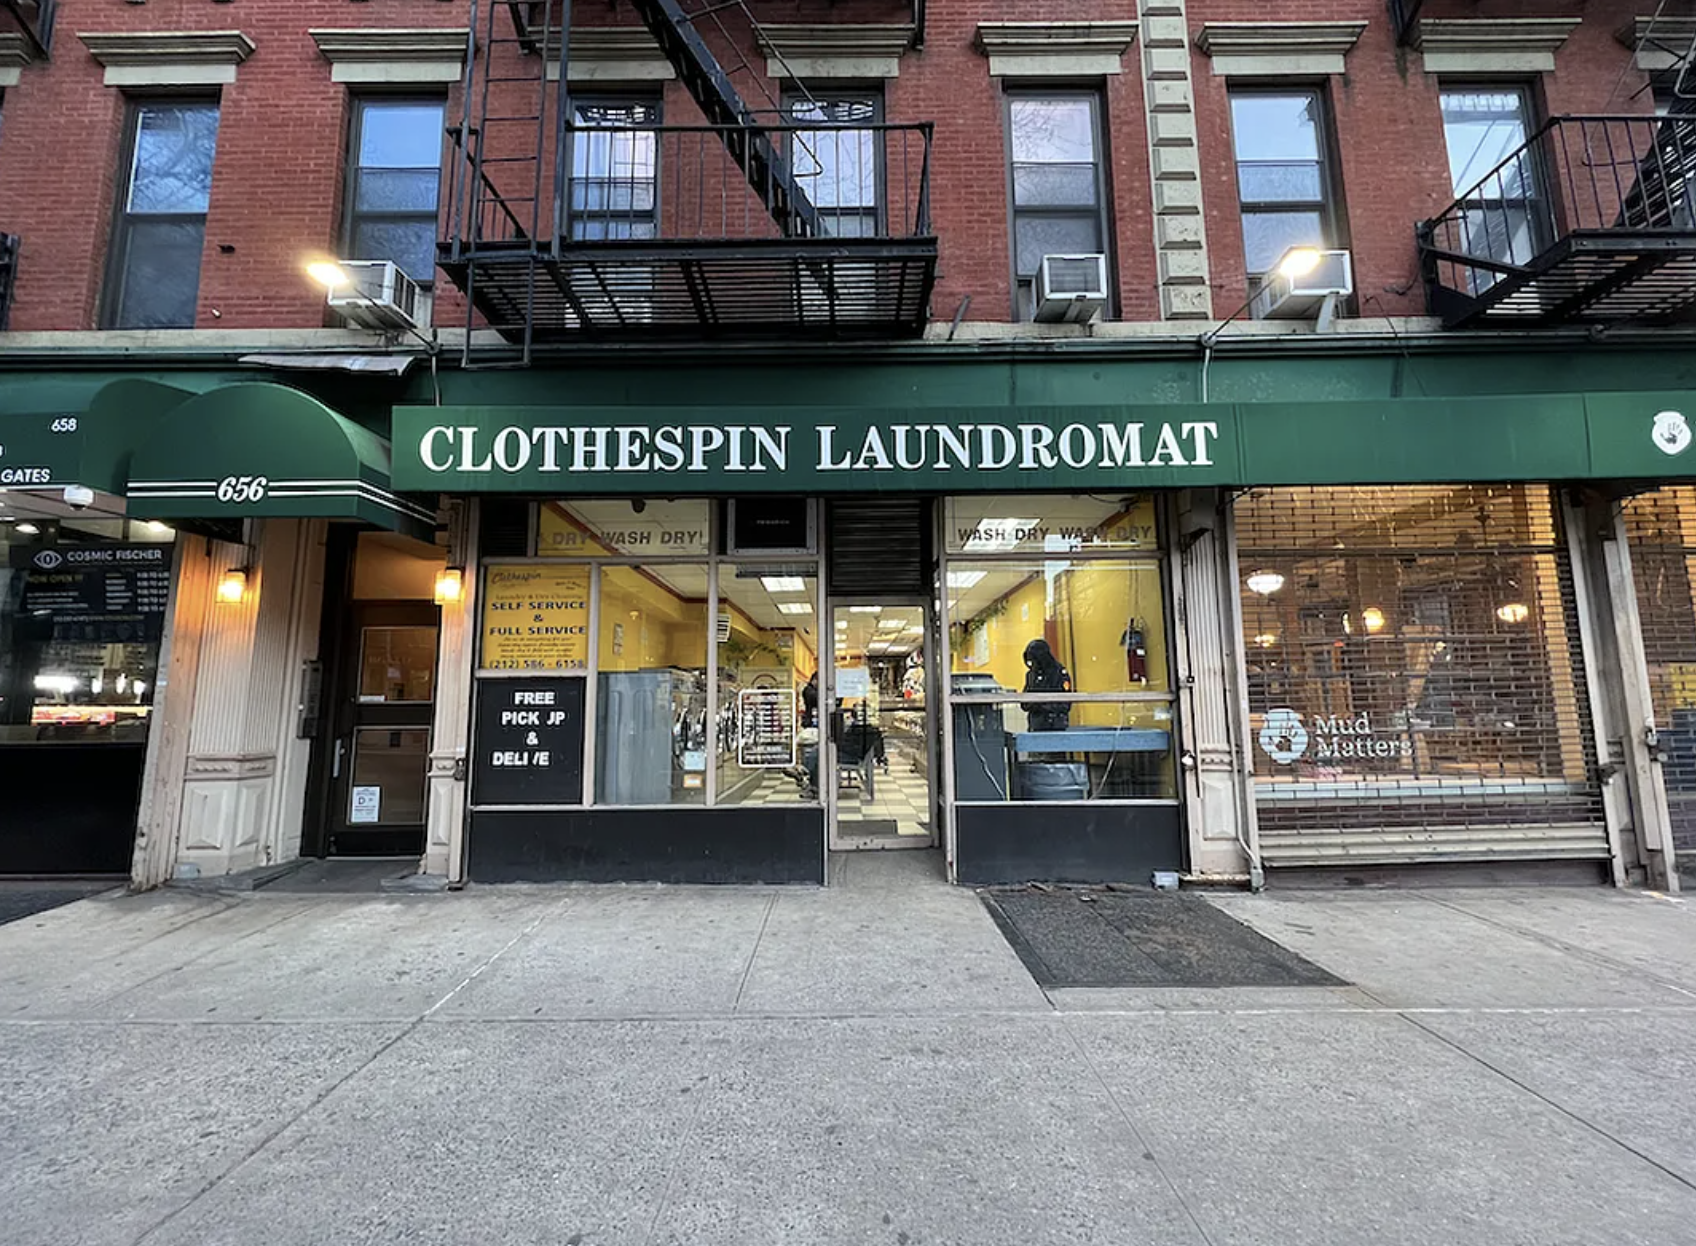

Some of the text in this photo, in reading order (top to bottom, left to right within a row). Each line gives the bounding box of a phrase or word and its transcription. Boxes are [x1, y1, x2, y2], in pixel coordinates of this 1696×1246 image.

[51, 418, 77, 432] 658
[419, 422, 1219, 472] CLOTHESPIN LAUNDROMAT
[1, 468, 50, 482] GATES
[217, 476, 267, 501] 656
[552, 532, 589, 545] DRY
[600, 531, 651, 545] WASH
[958, 528, 1006, 542] WASH
[1015, 528, 1050, 541] DRY
[1116, 526, 1152, 540] DRY
[66, 549, 162, 561] COSMIC FISCHER
[491, 600, 586, 611] SELF SERVICE
[533, 614, 544, 622] &
[489, 626, 586, 636] FULL SERVICE
[489, 660, 519, 669] (212)
[514, 691, 556, 705] FREE
[501, 711, 540, 725] PICK
[1313, 711, 1371, 734] Mud
[526, 731, 539, 745] &
[1315, 736, 1412, 757] Matters
